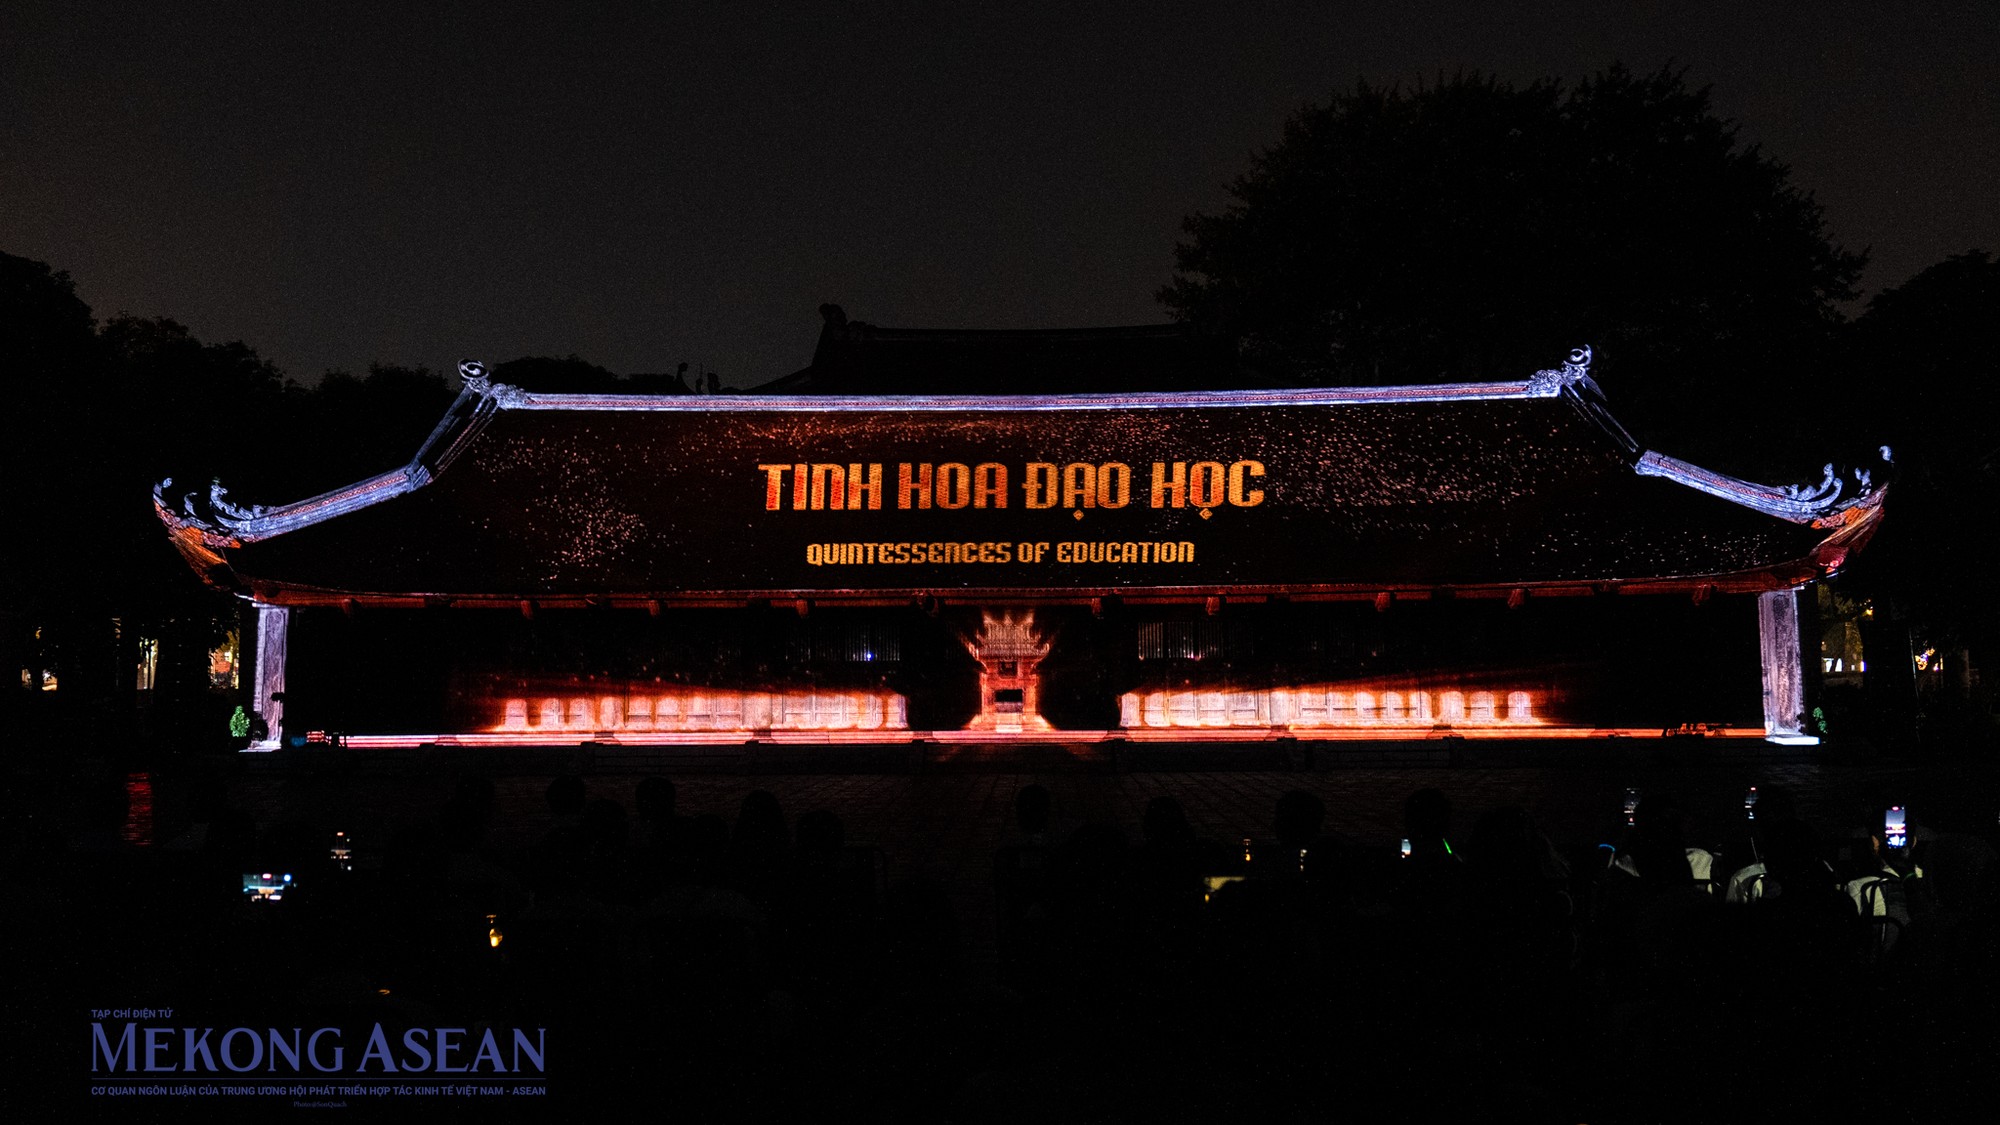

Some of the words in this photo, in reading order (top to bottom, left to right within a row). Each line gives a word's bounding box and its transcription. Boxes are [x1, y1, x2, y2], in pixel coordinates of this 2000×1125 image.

[758, 463, 883, 511] TINH
[898, 462, 1009, 510] HOA
[1022, 462, 1132, 521] ĐẠO
[1151, 460, 1266, 520] HỌC
[806, 542, 1012, 566] QUINTESSENCES
[1018, 541, 1050, 563] OF
[1056, 541, 1195, 564] EDUCATION
